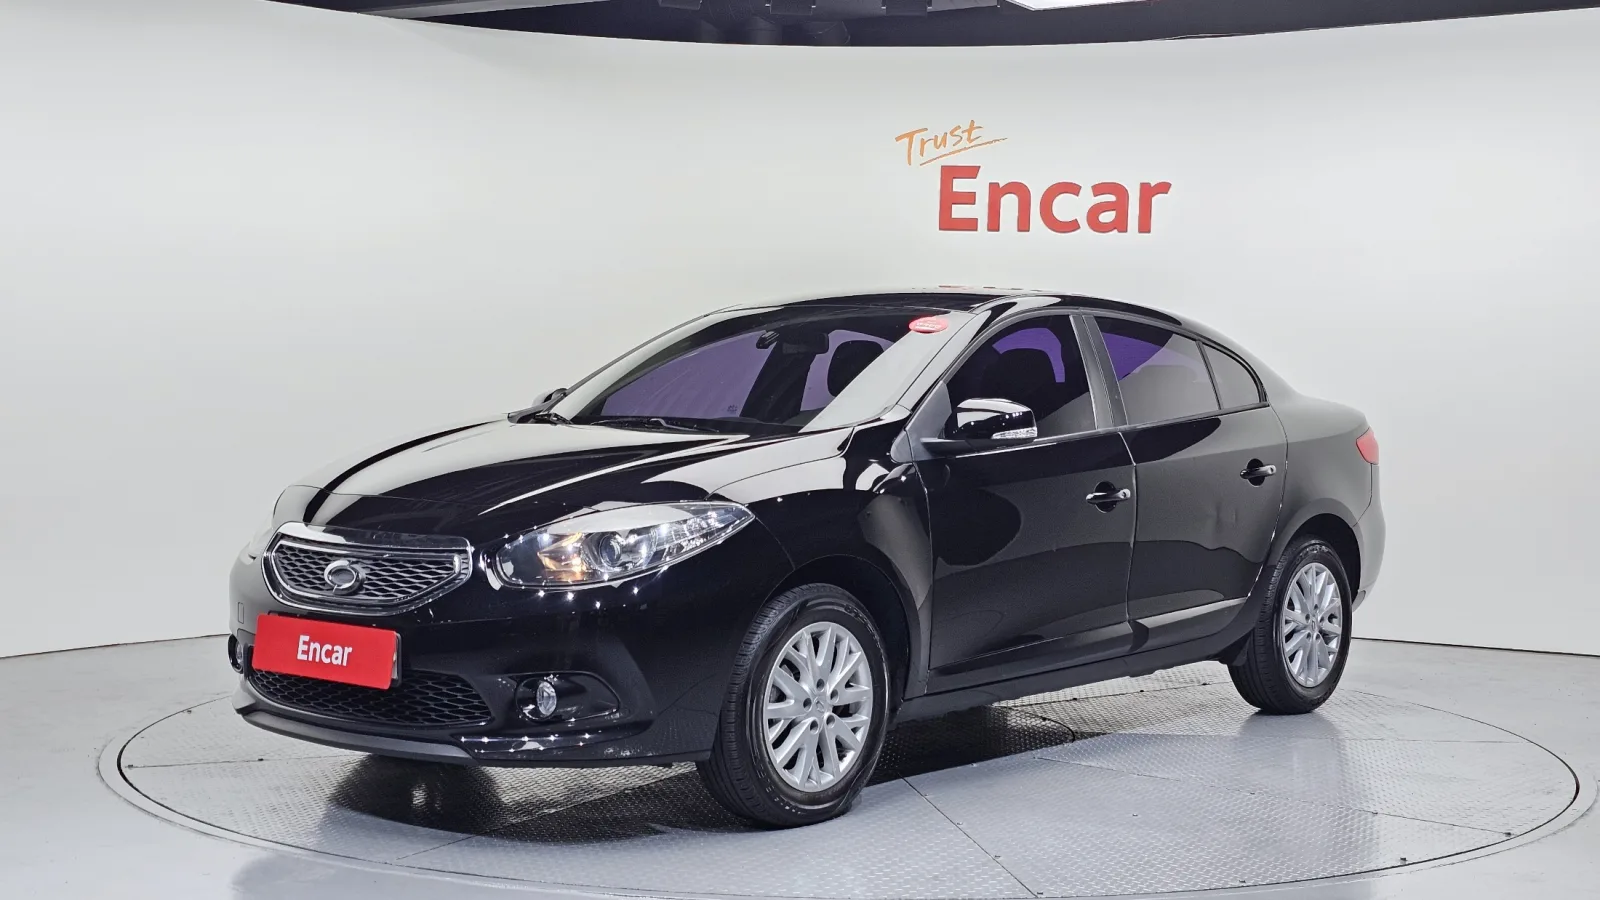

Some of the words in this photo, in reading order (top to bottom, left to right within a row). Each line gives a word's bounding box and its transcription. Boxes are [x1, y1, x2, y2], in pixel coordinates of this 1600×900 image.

[895, 119, 984, 165] Trust
[938, 165, 1172, 233] Encar
[296, 635, 352, 666] Encar
